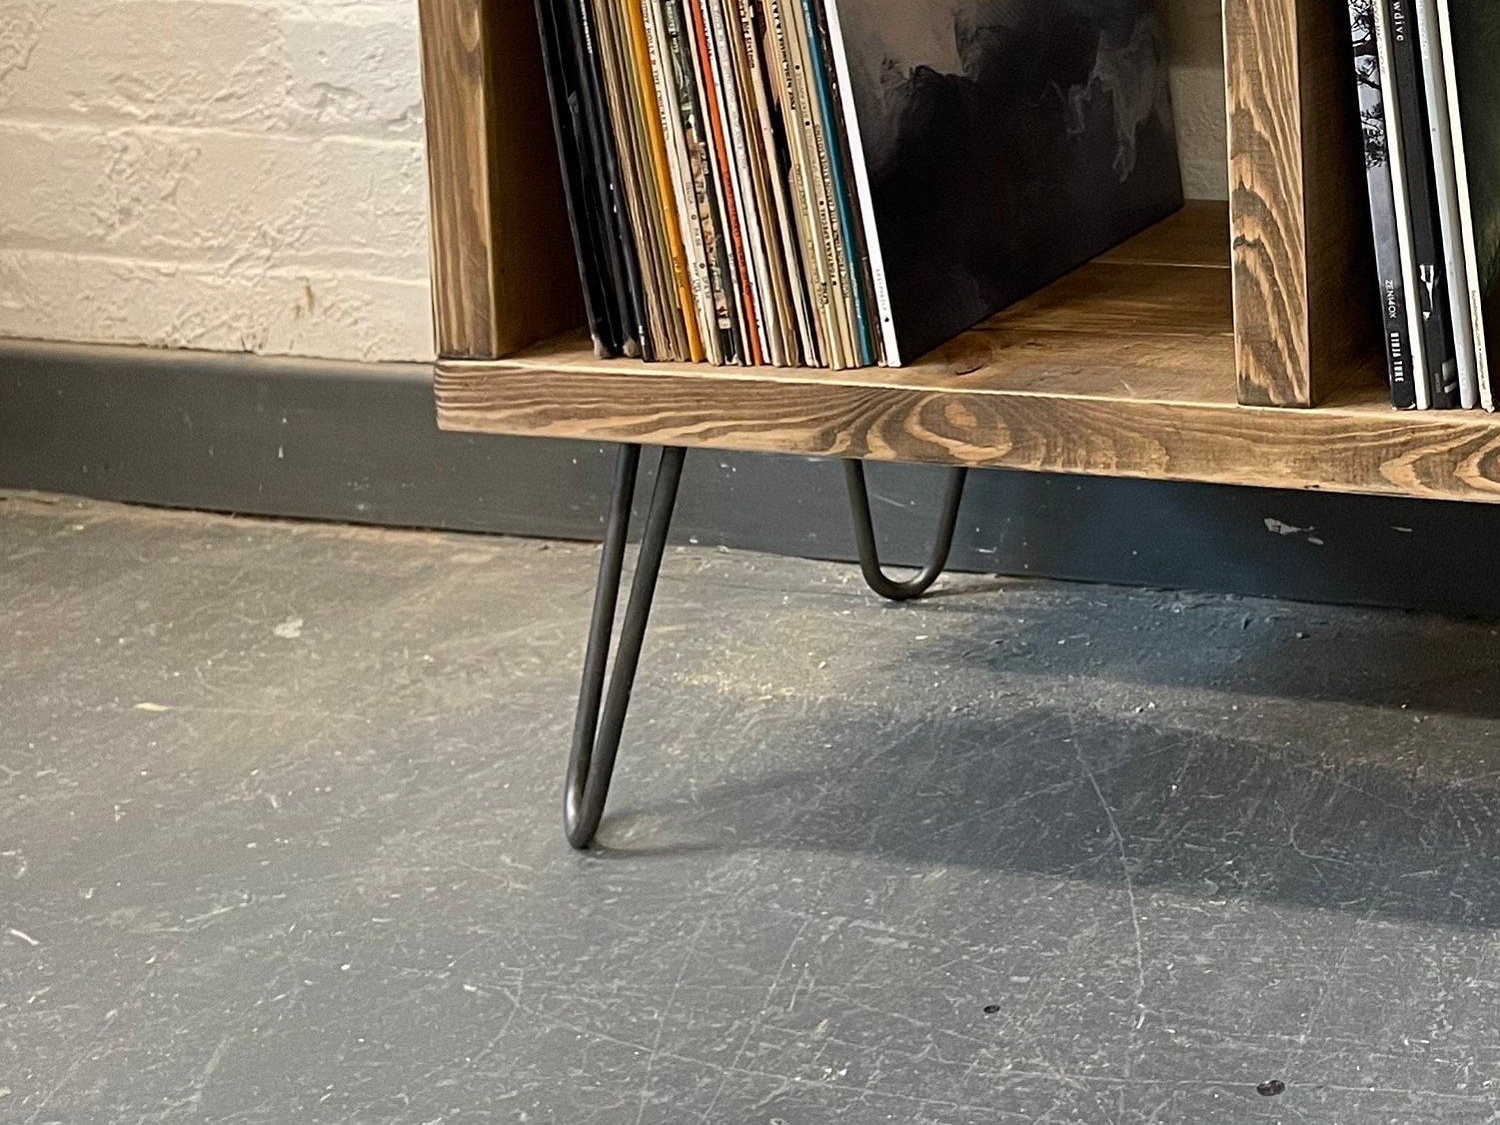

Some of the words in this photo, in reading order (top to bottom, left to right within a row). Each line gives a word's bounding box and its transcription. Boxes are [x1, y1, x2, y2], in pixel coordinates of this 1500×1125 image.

[644, 27, 655, 55] HOLLY
[744, 36, 756, 68] Sixteen
[684, 181, 694, 204] DECCA
[818, 208, 830, 240] SPECIAL
[824, 241, 836, 278] FONTANA
[1389, 331, 1402, 357] NINJA
[1392, 360, 1404, 382] TUNE
